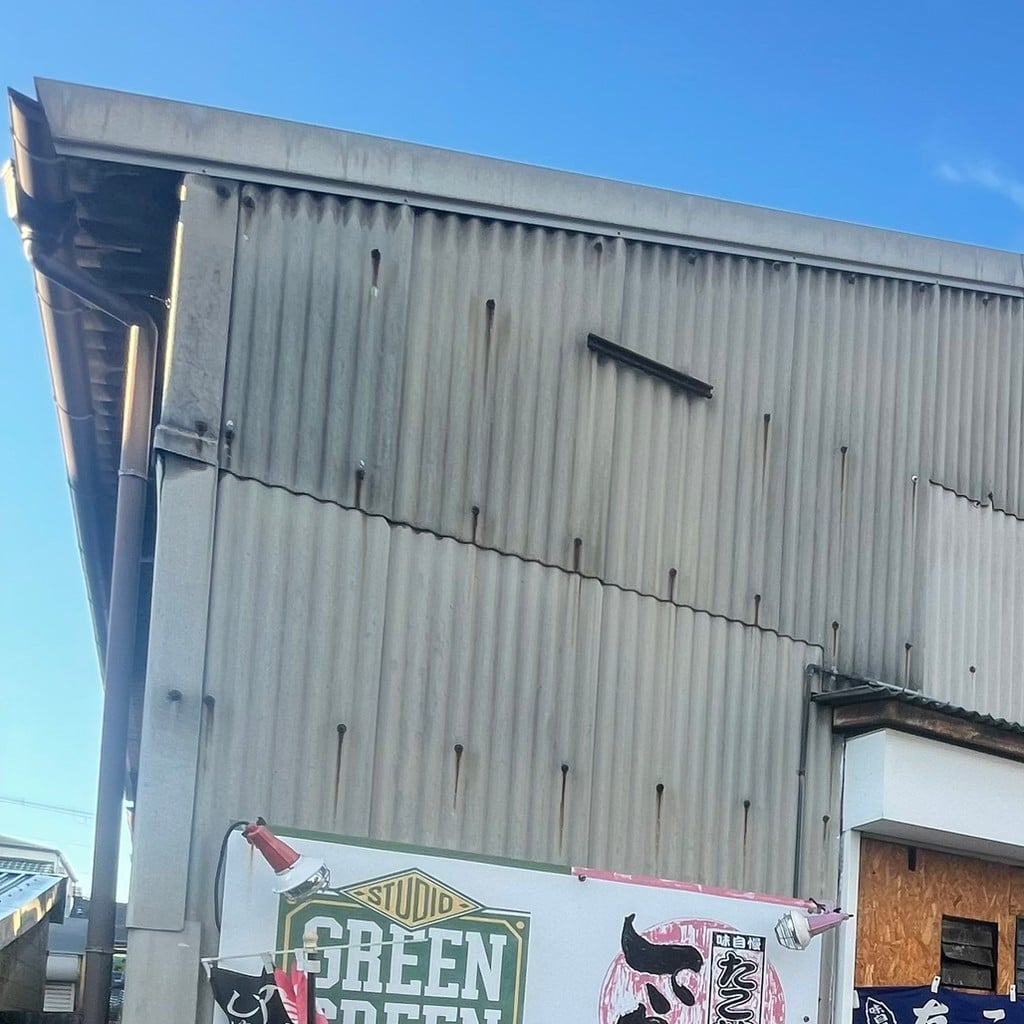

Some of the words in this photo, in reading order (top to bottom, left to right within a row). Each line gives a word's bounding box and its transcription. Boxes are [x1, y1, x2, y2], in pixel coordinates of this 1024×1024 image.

[368, 876, 453, 923] STUDIO
[304, 916, 507, 1001] GREEN
[716, 934, 762, 951] 味自慢
